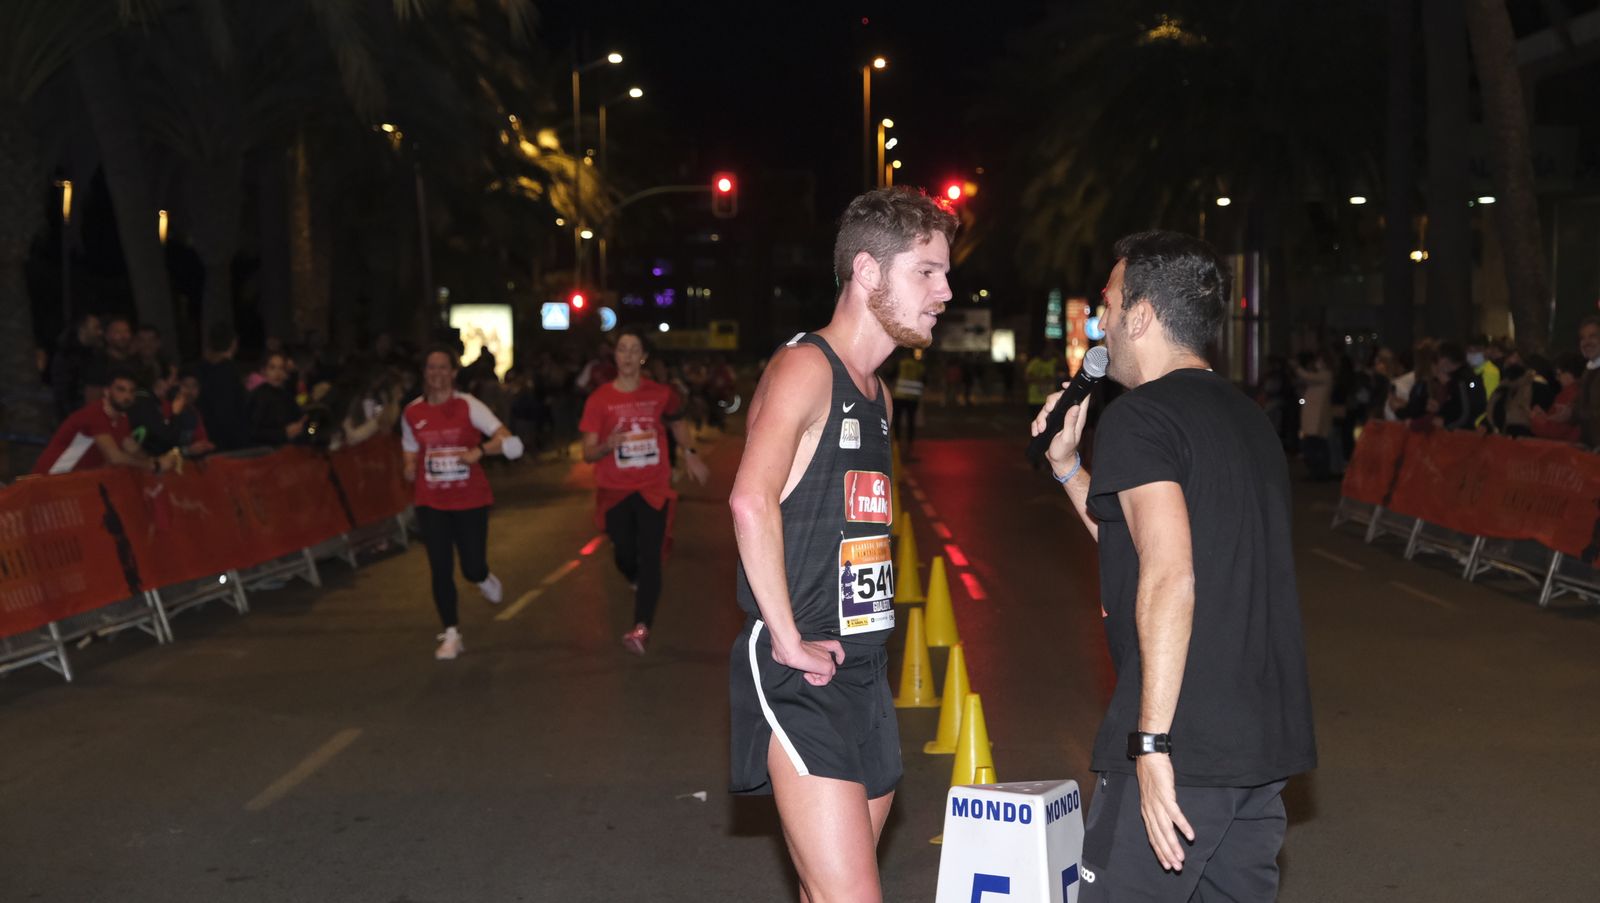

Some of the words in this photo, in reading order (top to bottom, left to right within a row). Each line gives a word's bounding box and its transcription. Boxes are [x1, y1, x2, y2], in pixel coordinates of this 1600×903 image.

[857, 564, 893, 599] 541
[952, 797, 1032, 824] MONDO
[1046, 789, 1079, 825] MONDO
